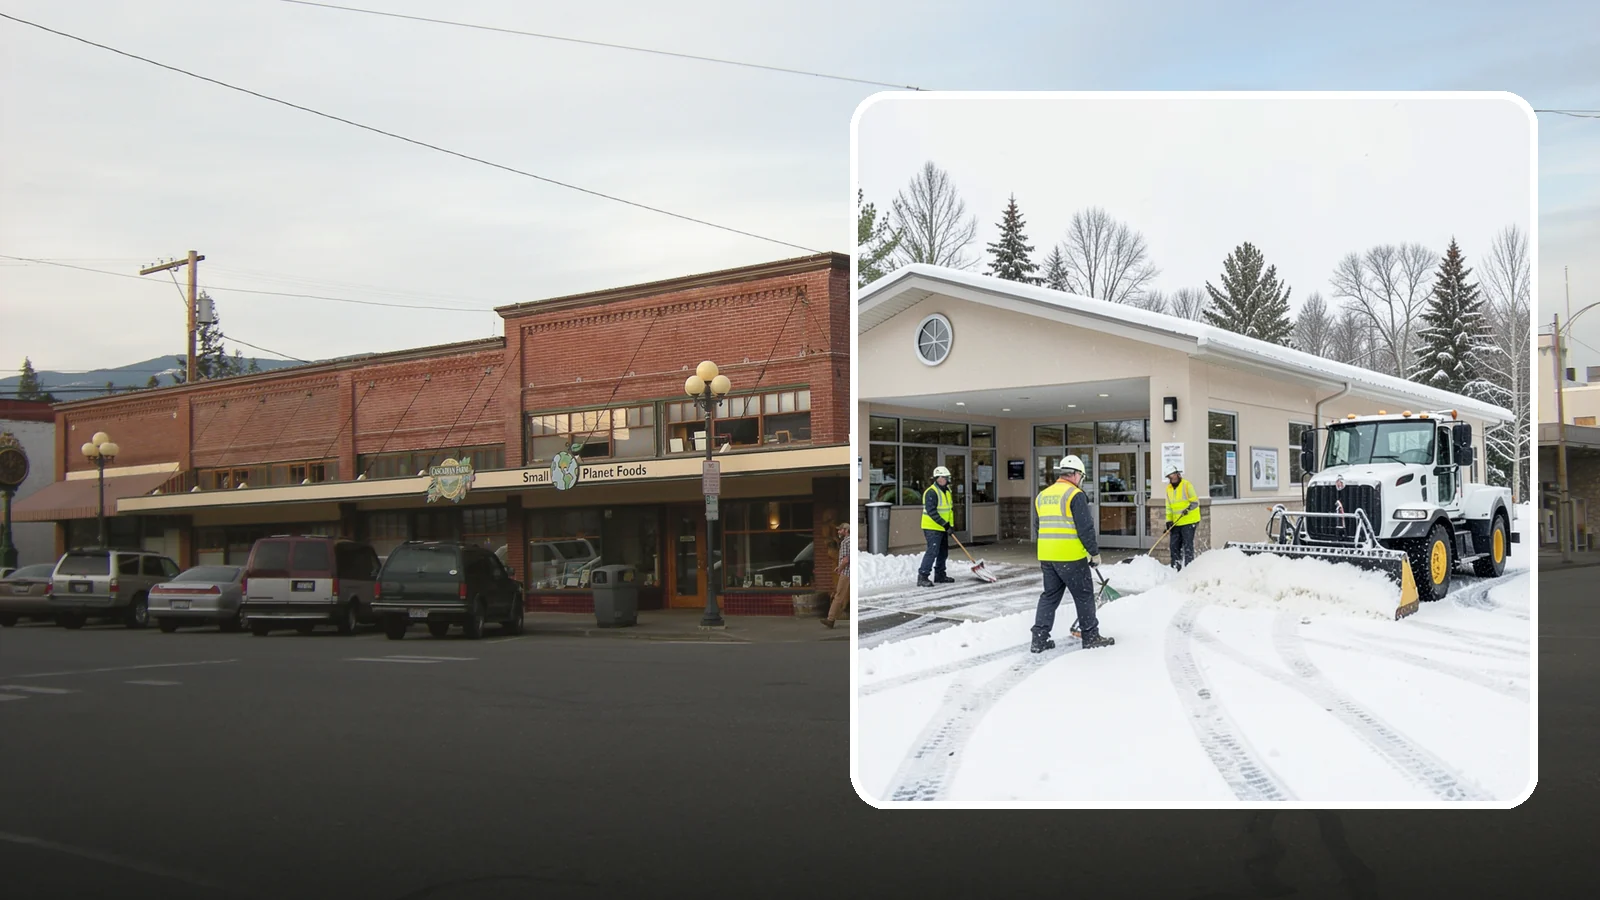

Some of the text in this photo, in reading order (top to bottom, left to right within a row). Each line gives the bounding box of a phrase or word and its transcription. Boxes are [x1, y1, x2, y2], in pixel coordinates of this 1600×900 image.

[523, 465, 647, 483] Small Planet Foods
